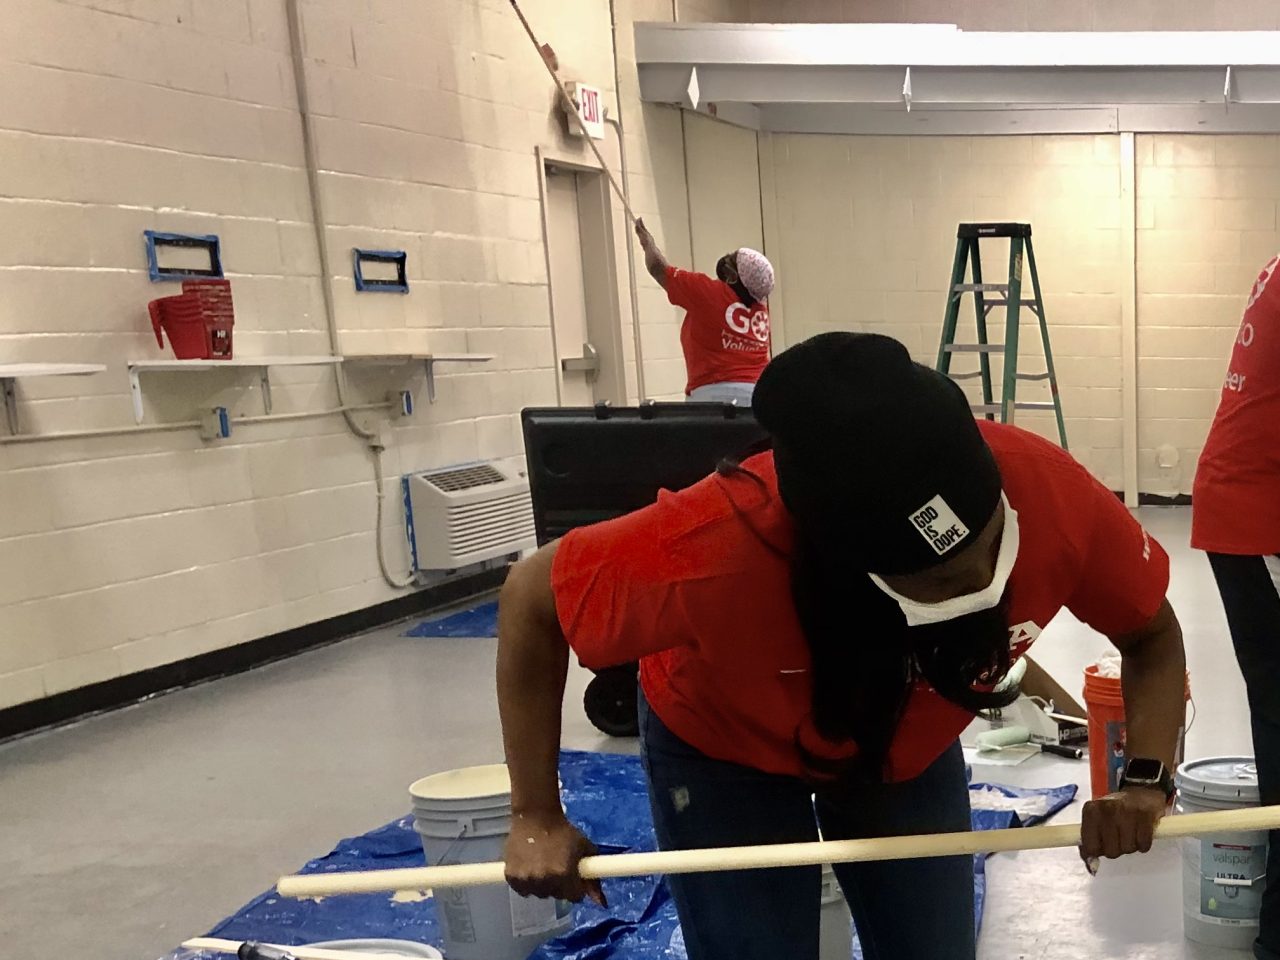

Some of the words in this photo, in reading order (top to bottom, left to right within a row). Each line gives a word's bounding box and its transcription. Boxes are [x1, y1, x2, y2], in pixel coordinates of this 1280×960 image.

[581, 87, 600, 124] EXIT
[913, 505, 939, 529] GOD
[922, 524, 939, 541] IS
[932, 523, 967, 552] DOPE.
[1212, 852, 1250, 867] valspar
